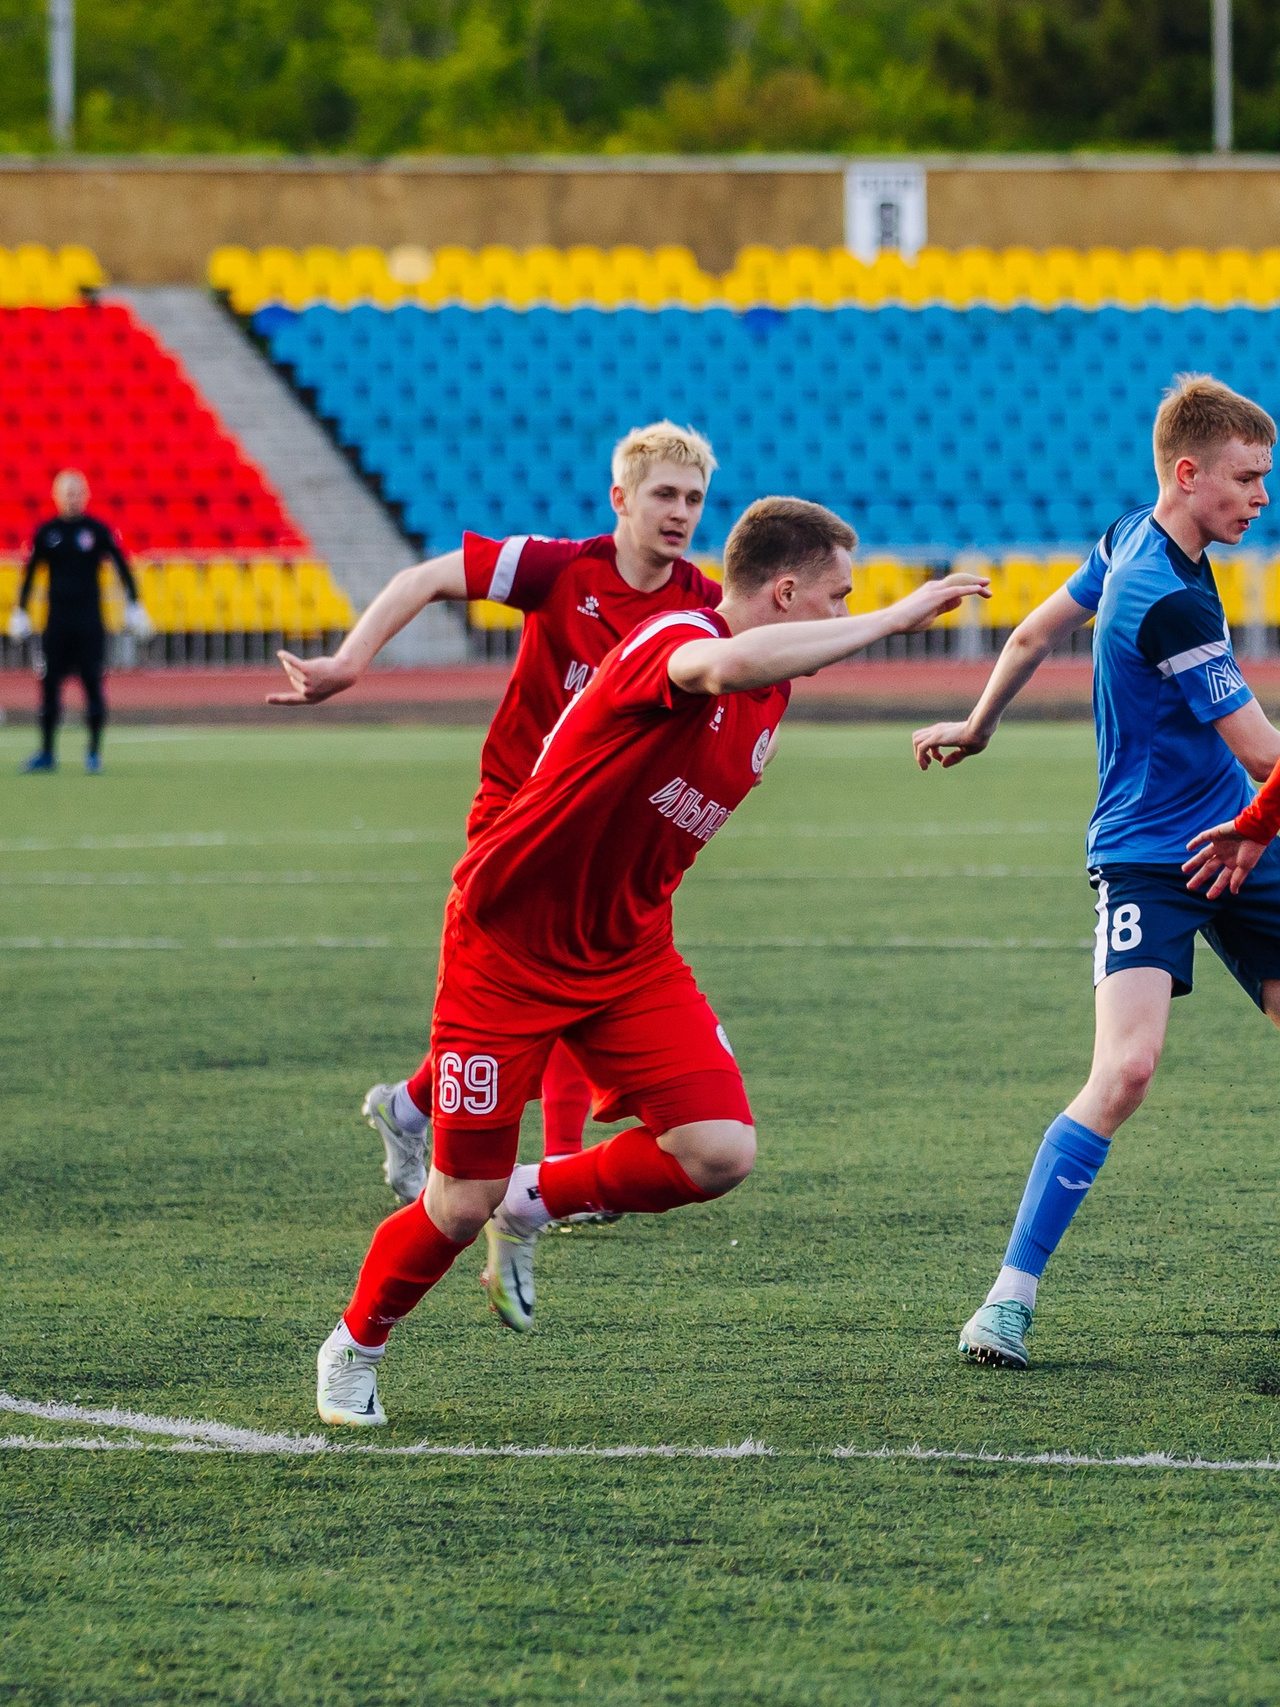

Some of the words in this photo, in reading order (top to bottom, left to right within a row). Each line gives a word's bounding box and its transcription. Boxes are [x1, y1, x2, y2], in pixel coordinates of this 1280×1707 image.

[648, 776, 733, 842] ИЛЬПА
[1111, 903, 1143, 952] 8
[438, 1051, 499, 1115] 69
